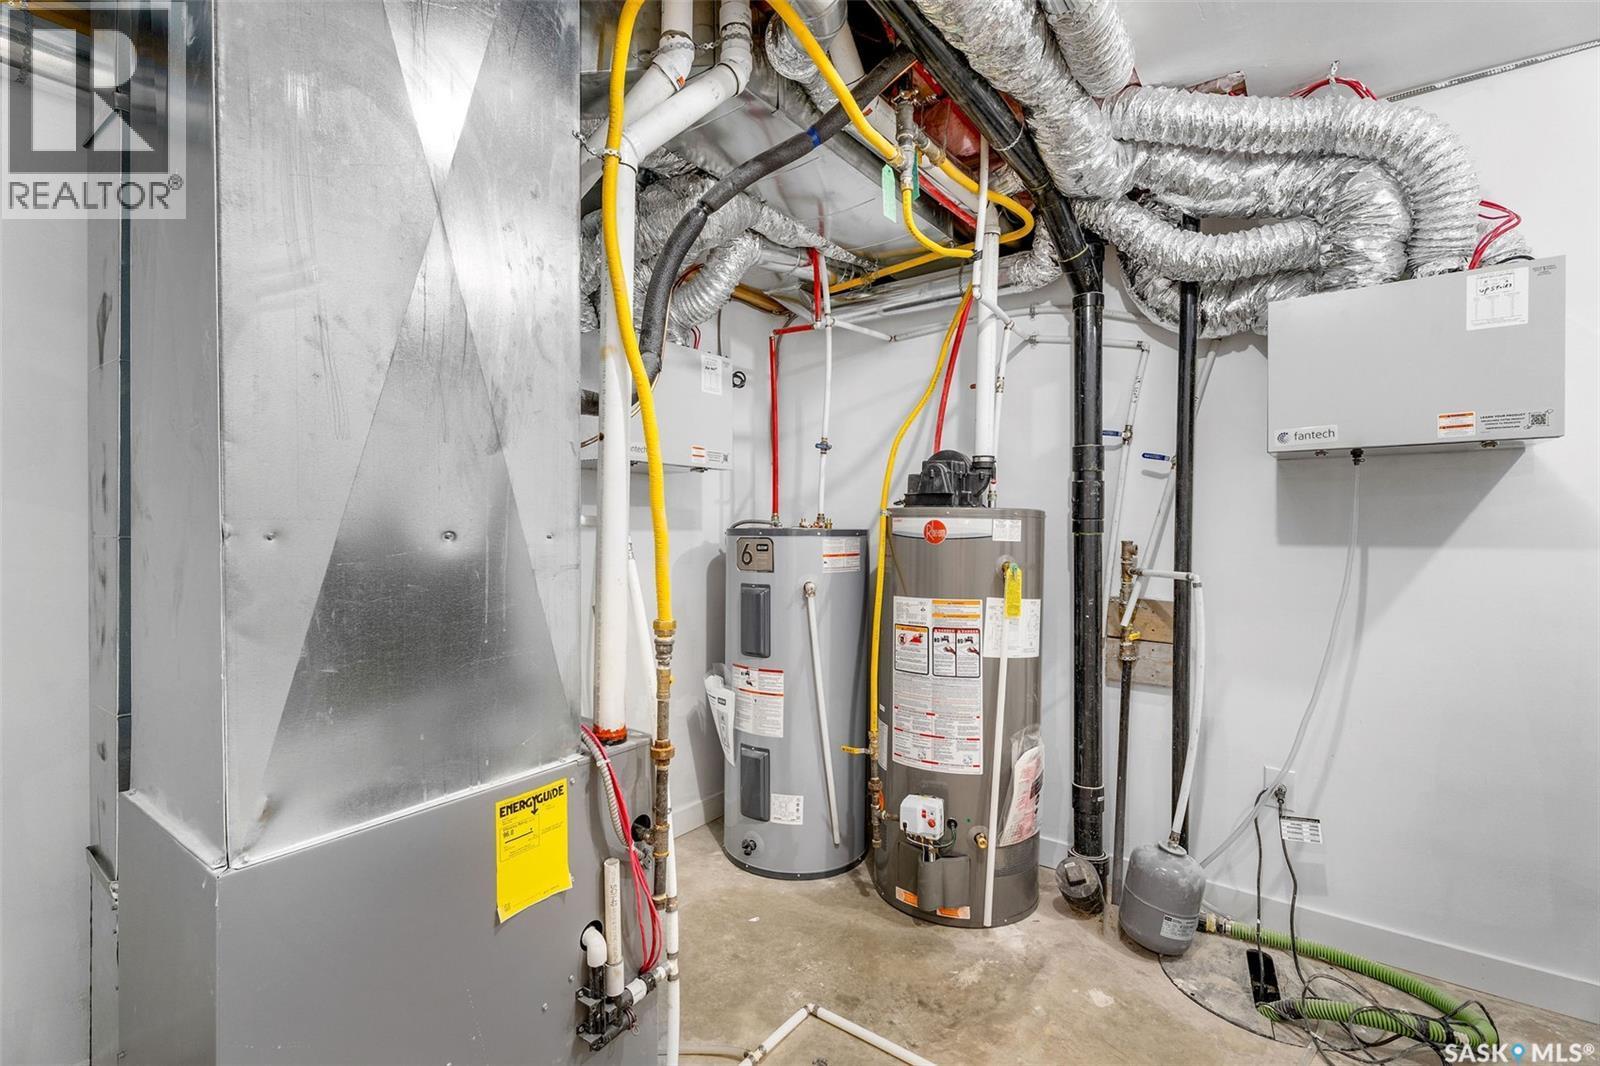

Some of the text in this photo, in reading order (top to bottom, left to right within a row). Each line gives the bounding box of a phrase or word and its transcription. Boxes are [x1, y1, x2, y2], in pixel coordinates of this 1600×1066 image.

[1294, 428, 1336, 441] fantech
[741, 543, 753, 566] 6
[499, 785, 565, 818] ENERGYGUIDE
